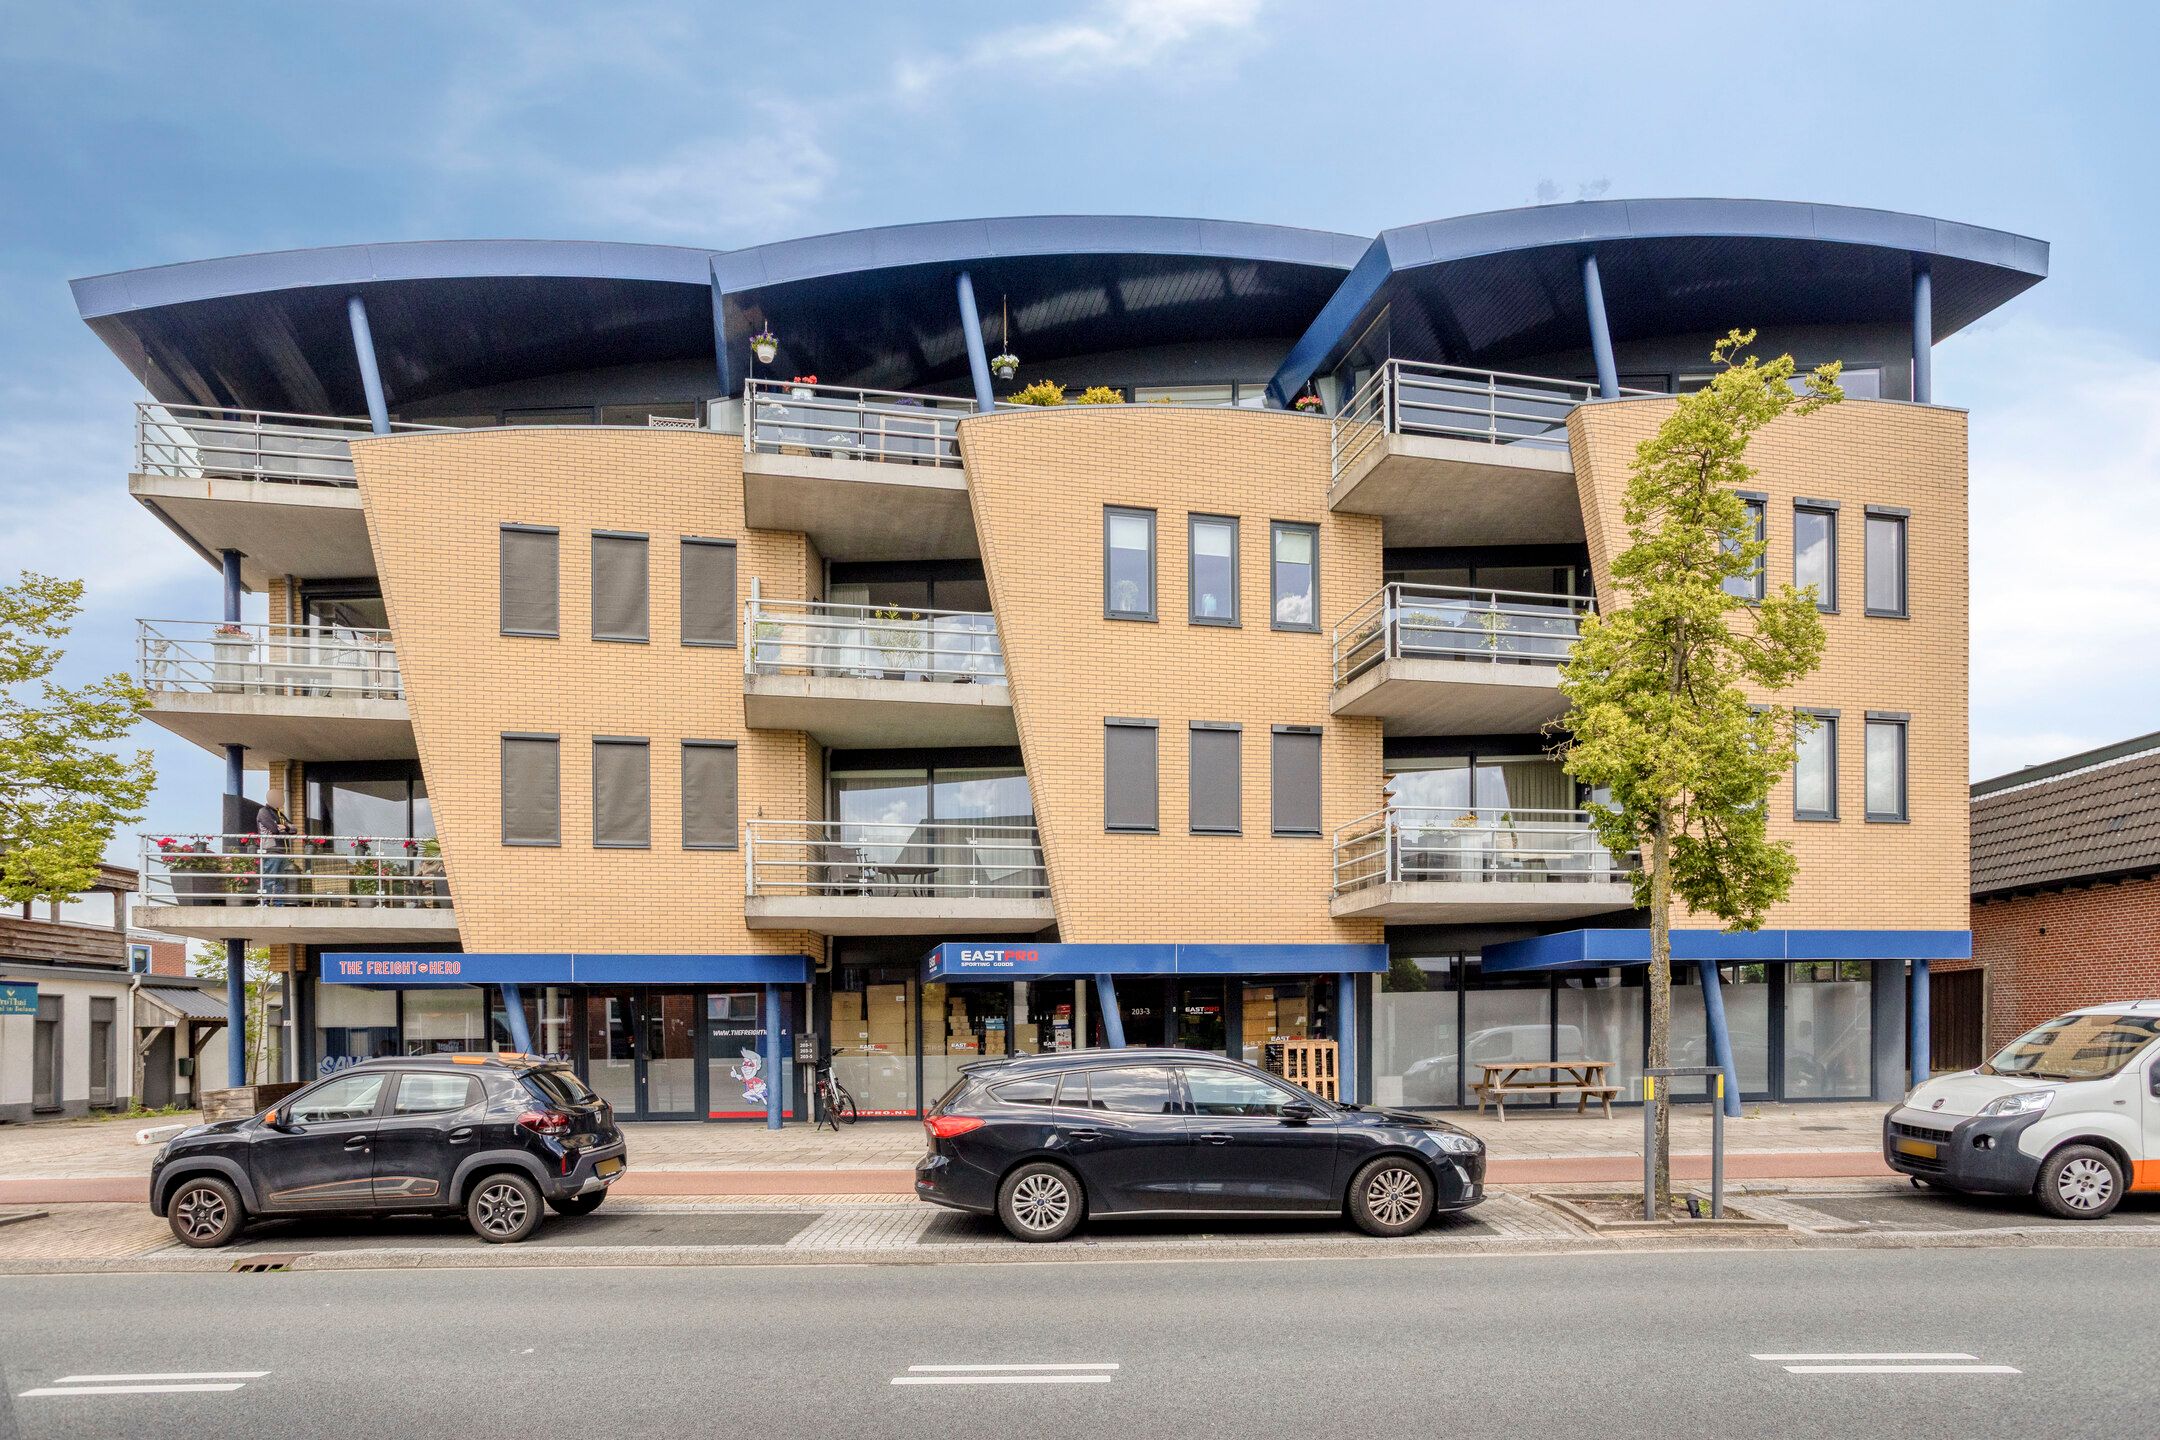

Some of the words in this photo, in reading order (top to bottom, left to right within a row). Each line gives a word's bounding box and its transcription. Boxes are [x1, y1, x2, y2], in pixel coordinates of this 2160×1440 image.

[961, 950, 1039, 961] EASTPRO
[339, 961, 363, 975] THE
[366, 961, 419, 975] FREIGHT
[429, 961, 461, 975] HERO
[1131, 1007, 1151, 1015] 203-3
